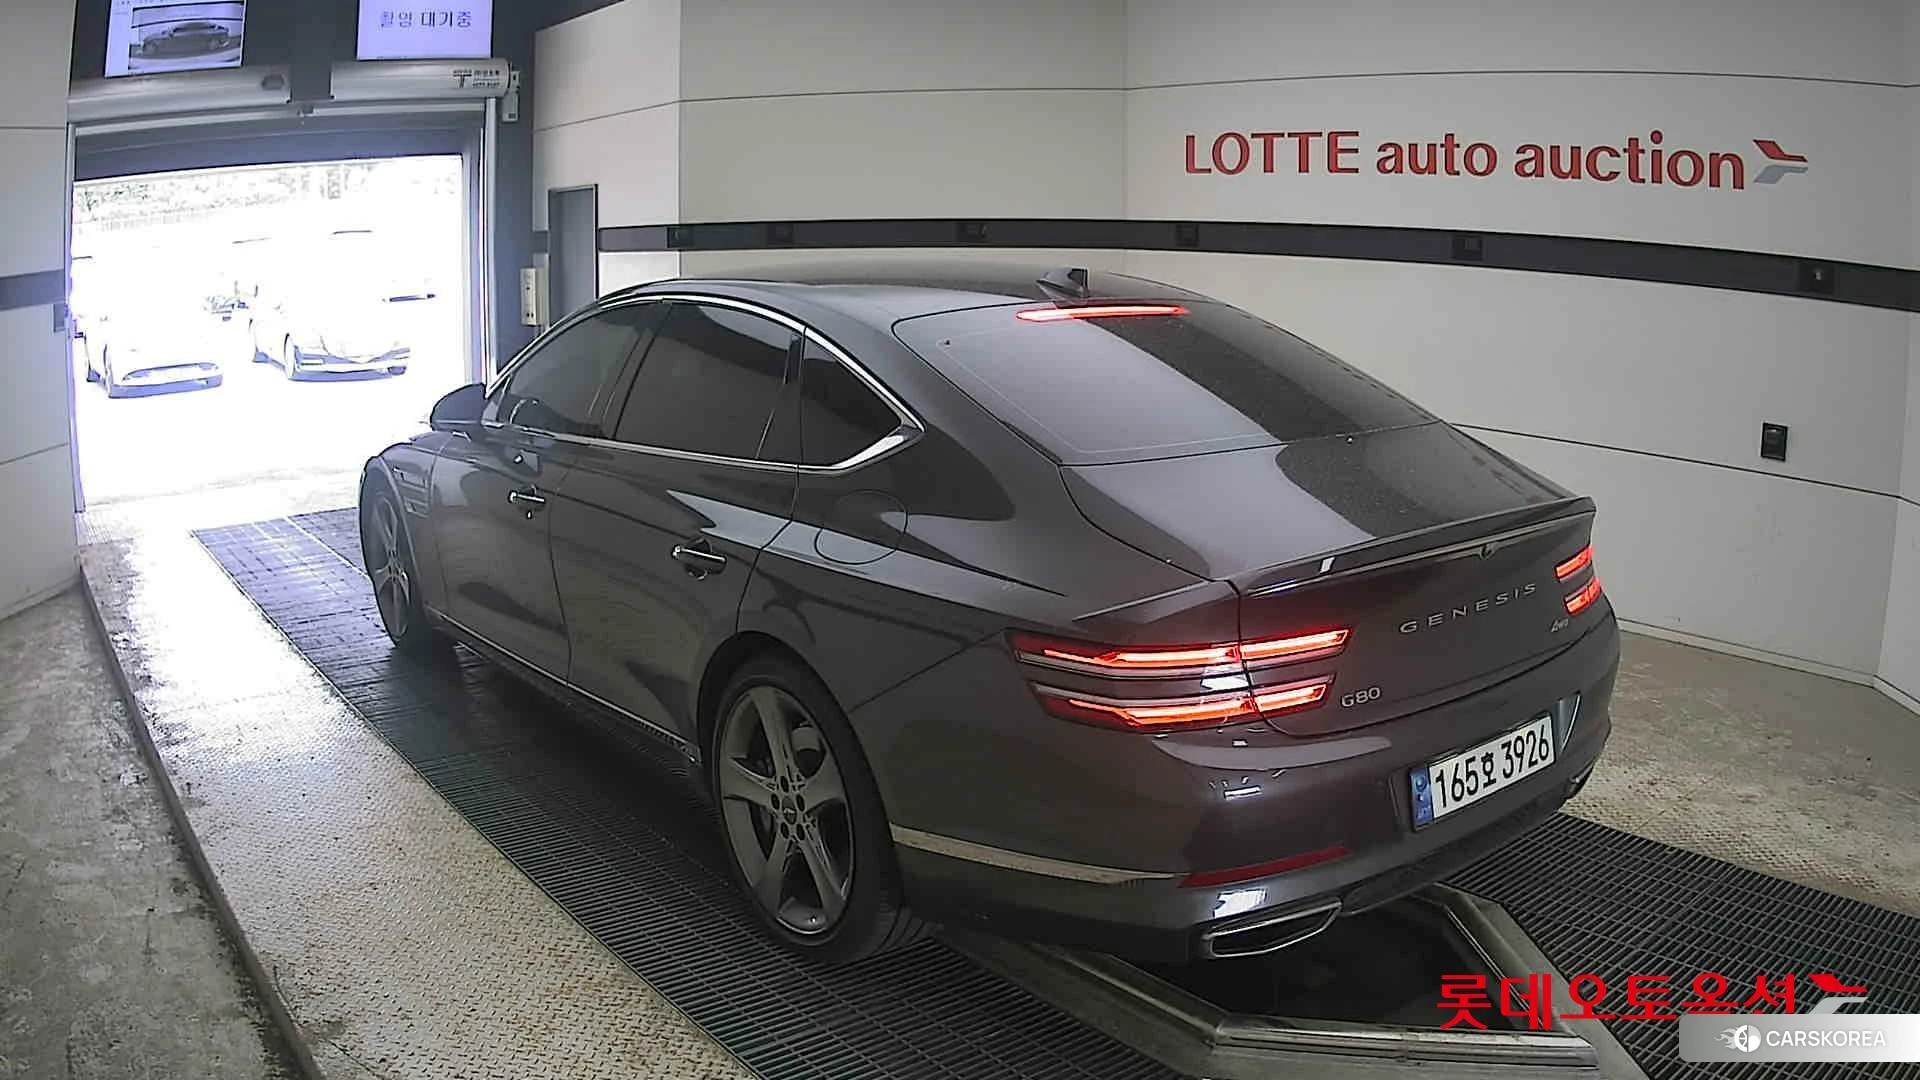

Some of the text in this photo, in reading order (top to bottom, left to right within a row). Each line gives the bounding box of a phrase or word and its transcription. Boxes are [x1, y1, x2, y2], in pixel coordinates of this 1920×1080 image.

[421, 11, 472, 28] 대기중
[1185, 129, 1745, 190] LOTTE auto auction
[1399, 582, 1537, 634] GENESIS
[1341, 686, 1381, 708] G80
[1436, 724, 1549, 808] 165호 3926
